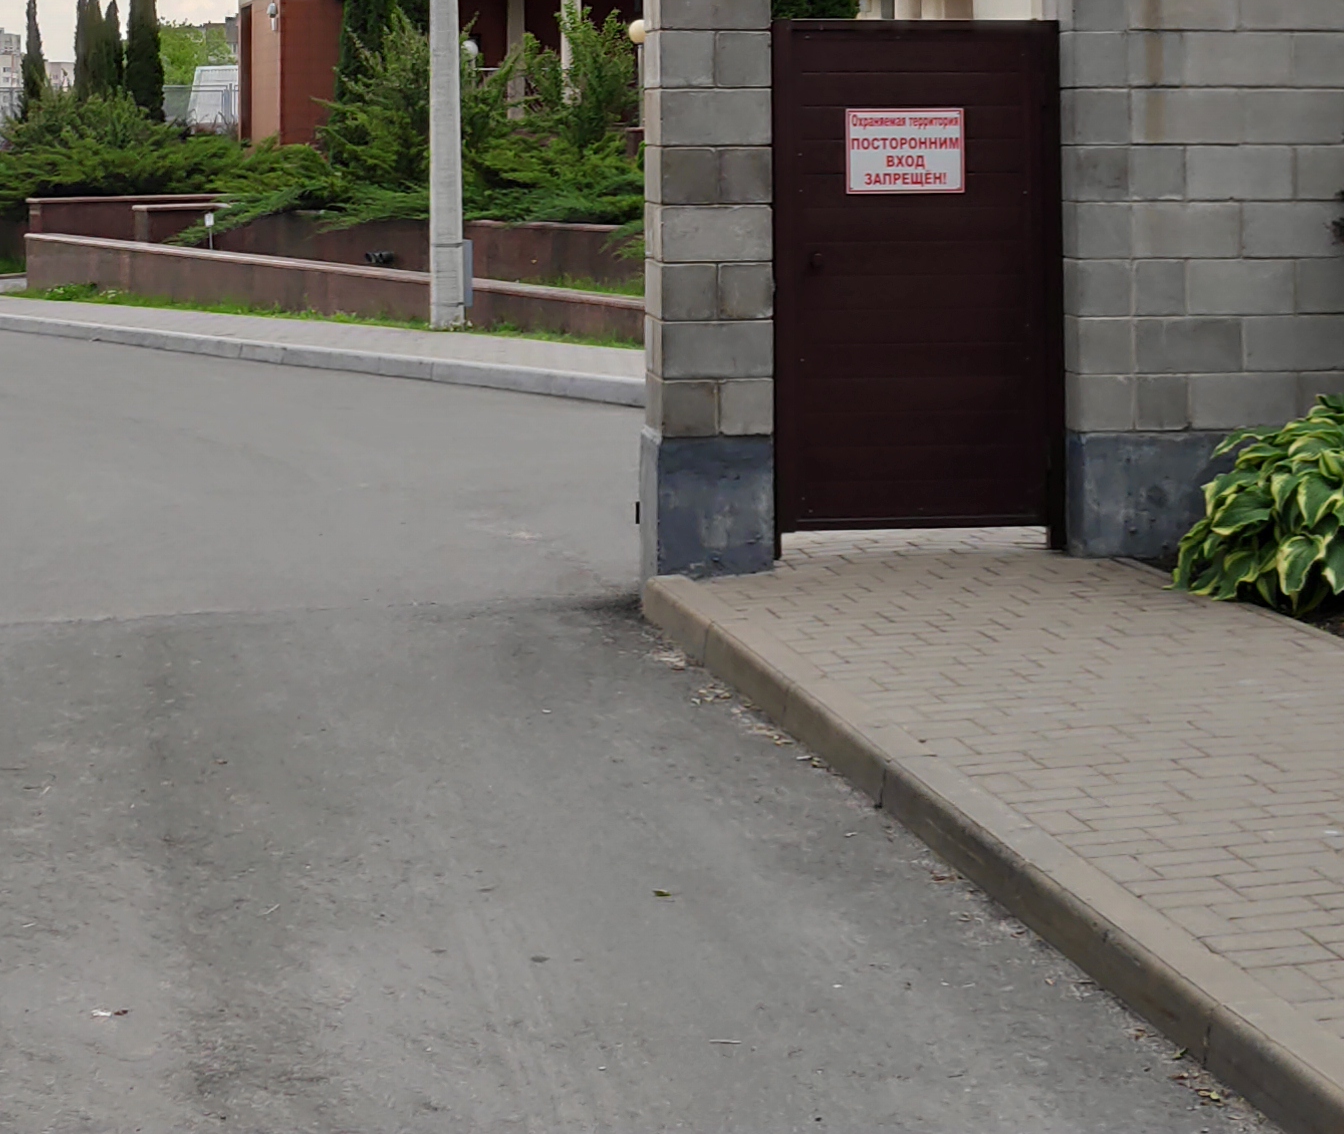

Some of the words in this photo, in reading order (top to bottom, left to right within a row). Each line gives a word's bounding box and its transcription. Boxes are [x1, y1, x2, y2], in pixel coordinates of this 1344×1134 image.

[851, 114, 907, 130] Охраняемая
[908, 116, 960, 130] территория
[851, 137, 960, 150] ПОСТОРОННИМ
[886, 155, 926, 169] ВХОД
